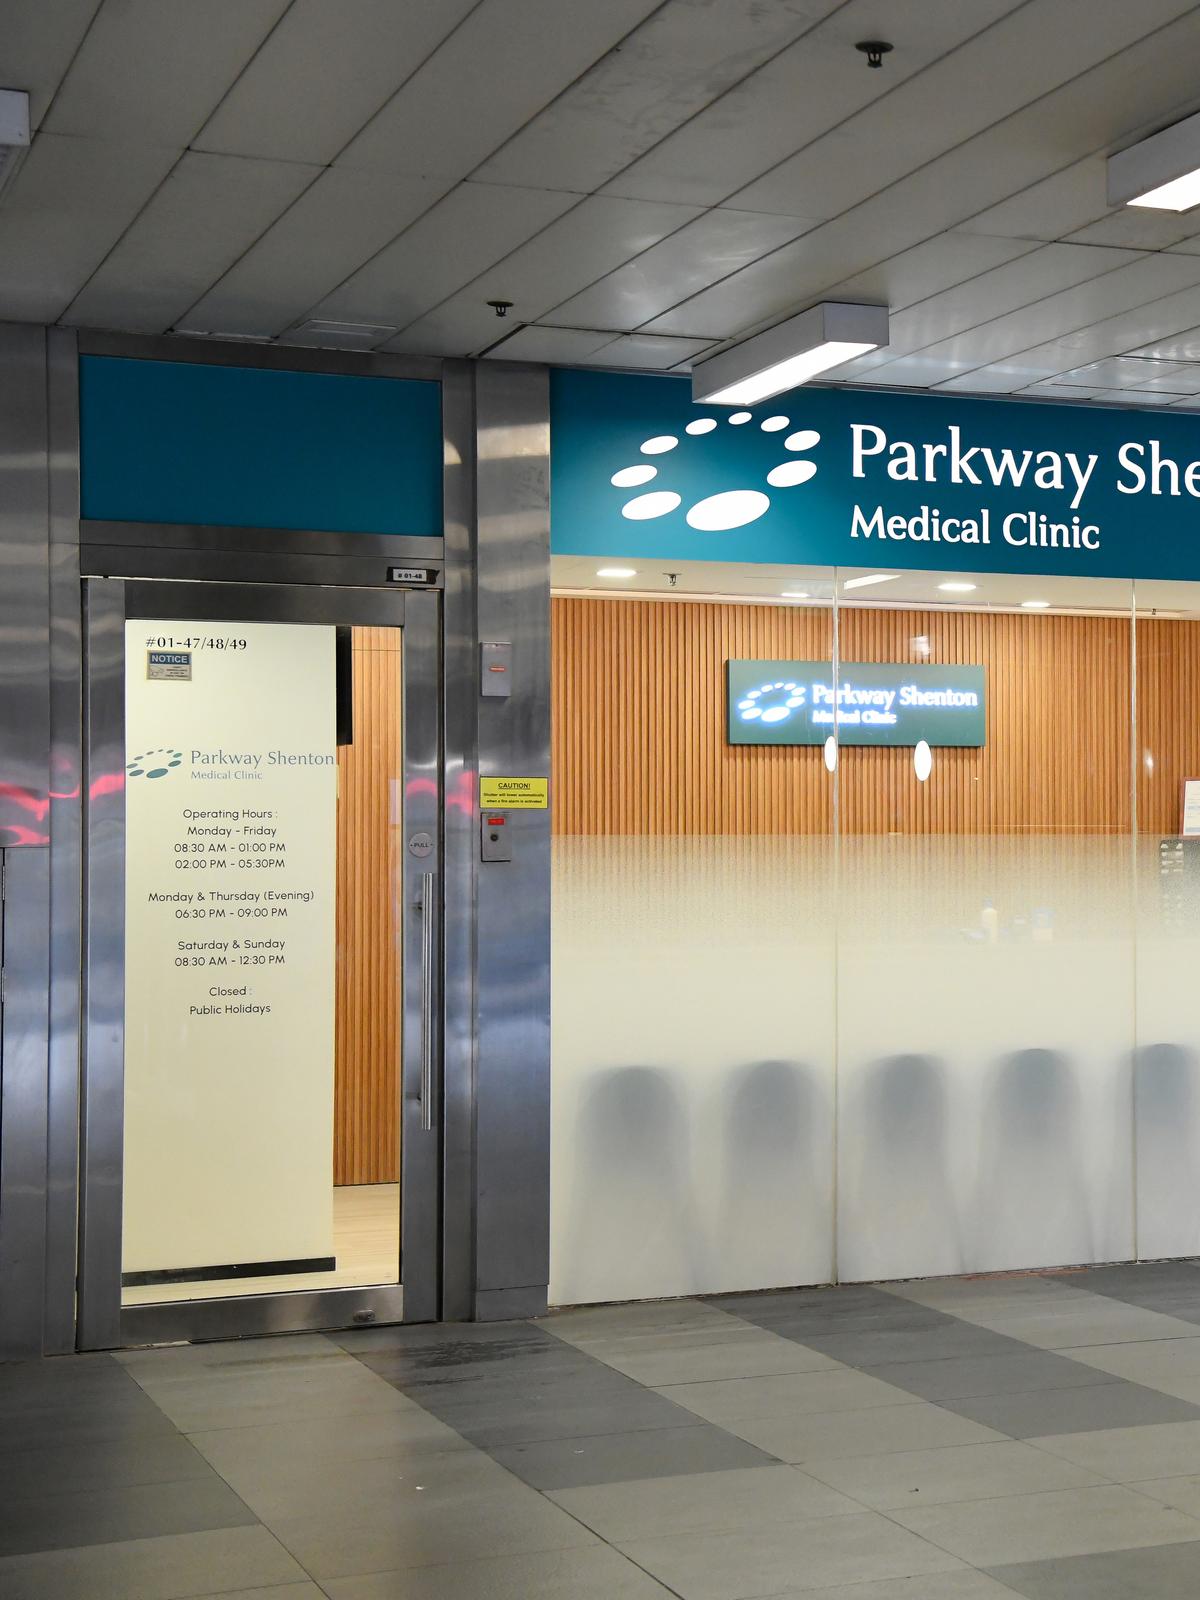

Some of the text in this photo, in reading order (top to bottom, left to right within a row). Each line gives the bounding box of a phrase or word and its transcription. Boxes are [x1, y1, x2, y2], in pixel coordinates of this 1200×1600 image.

[849, 423, 1098, 509] Parkway
[850, 505, 1100, 550] Medical Clinic
[146, 637, 247, 650] #01-47/48/49
[151, 654, 188, 663] NOTICE
[812, 684, 978, 710] Parkway Shenton
[191, 750, 334, 768] Parkway Shenton
[191, 770, 263, 780] Medical Clinic
[183, 809, 239, 821] Operating
[242, 809, 272, 818] Hours
[187, 826, 232, 837] Monday
[244, 826, 277, 837] Friday
[174, 843, 204, 853] 08:30
[208, 843, 227, 852] AM
[238, 843, 266, 852] 01:00
[270, 843, 286, 852] PM
[175, 860, 207, 869] 02:00
[210, 860, 226, 868] PM
[238, 859, 285, 868] 05:30PM
[148, 891, 314, 904] Monday & Thursday (Evening)
[175, 909, 206, 919] 06:30
[209, 909, 226, 918] PM
[237, 908, 268, 918] 09:00
[271, 908, 288, 917] PM
[178, 939, 285, 952] Saturday & Sunday
[175, 957, 205, 966] 08:30
[208, 957, 227, 966] AM
[240, 956, 265, 965] 12:30
[269, 955, 285, 964] PM
[209, 986, 246, 996] Closed
[190, 1004, 271, 1015] Public Holidays
